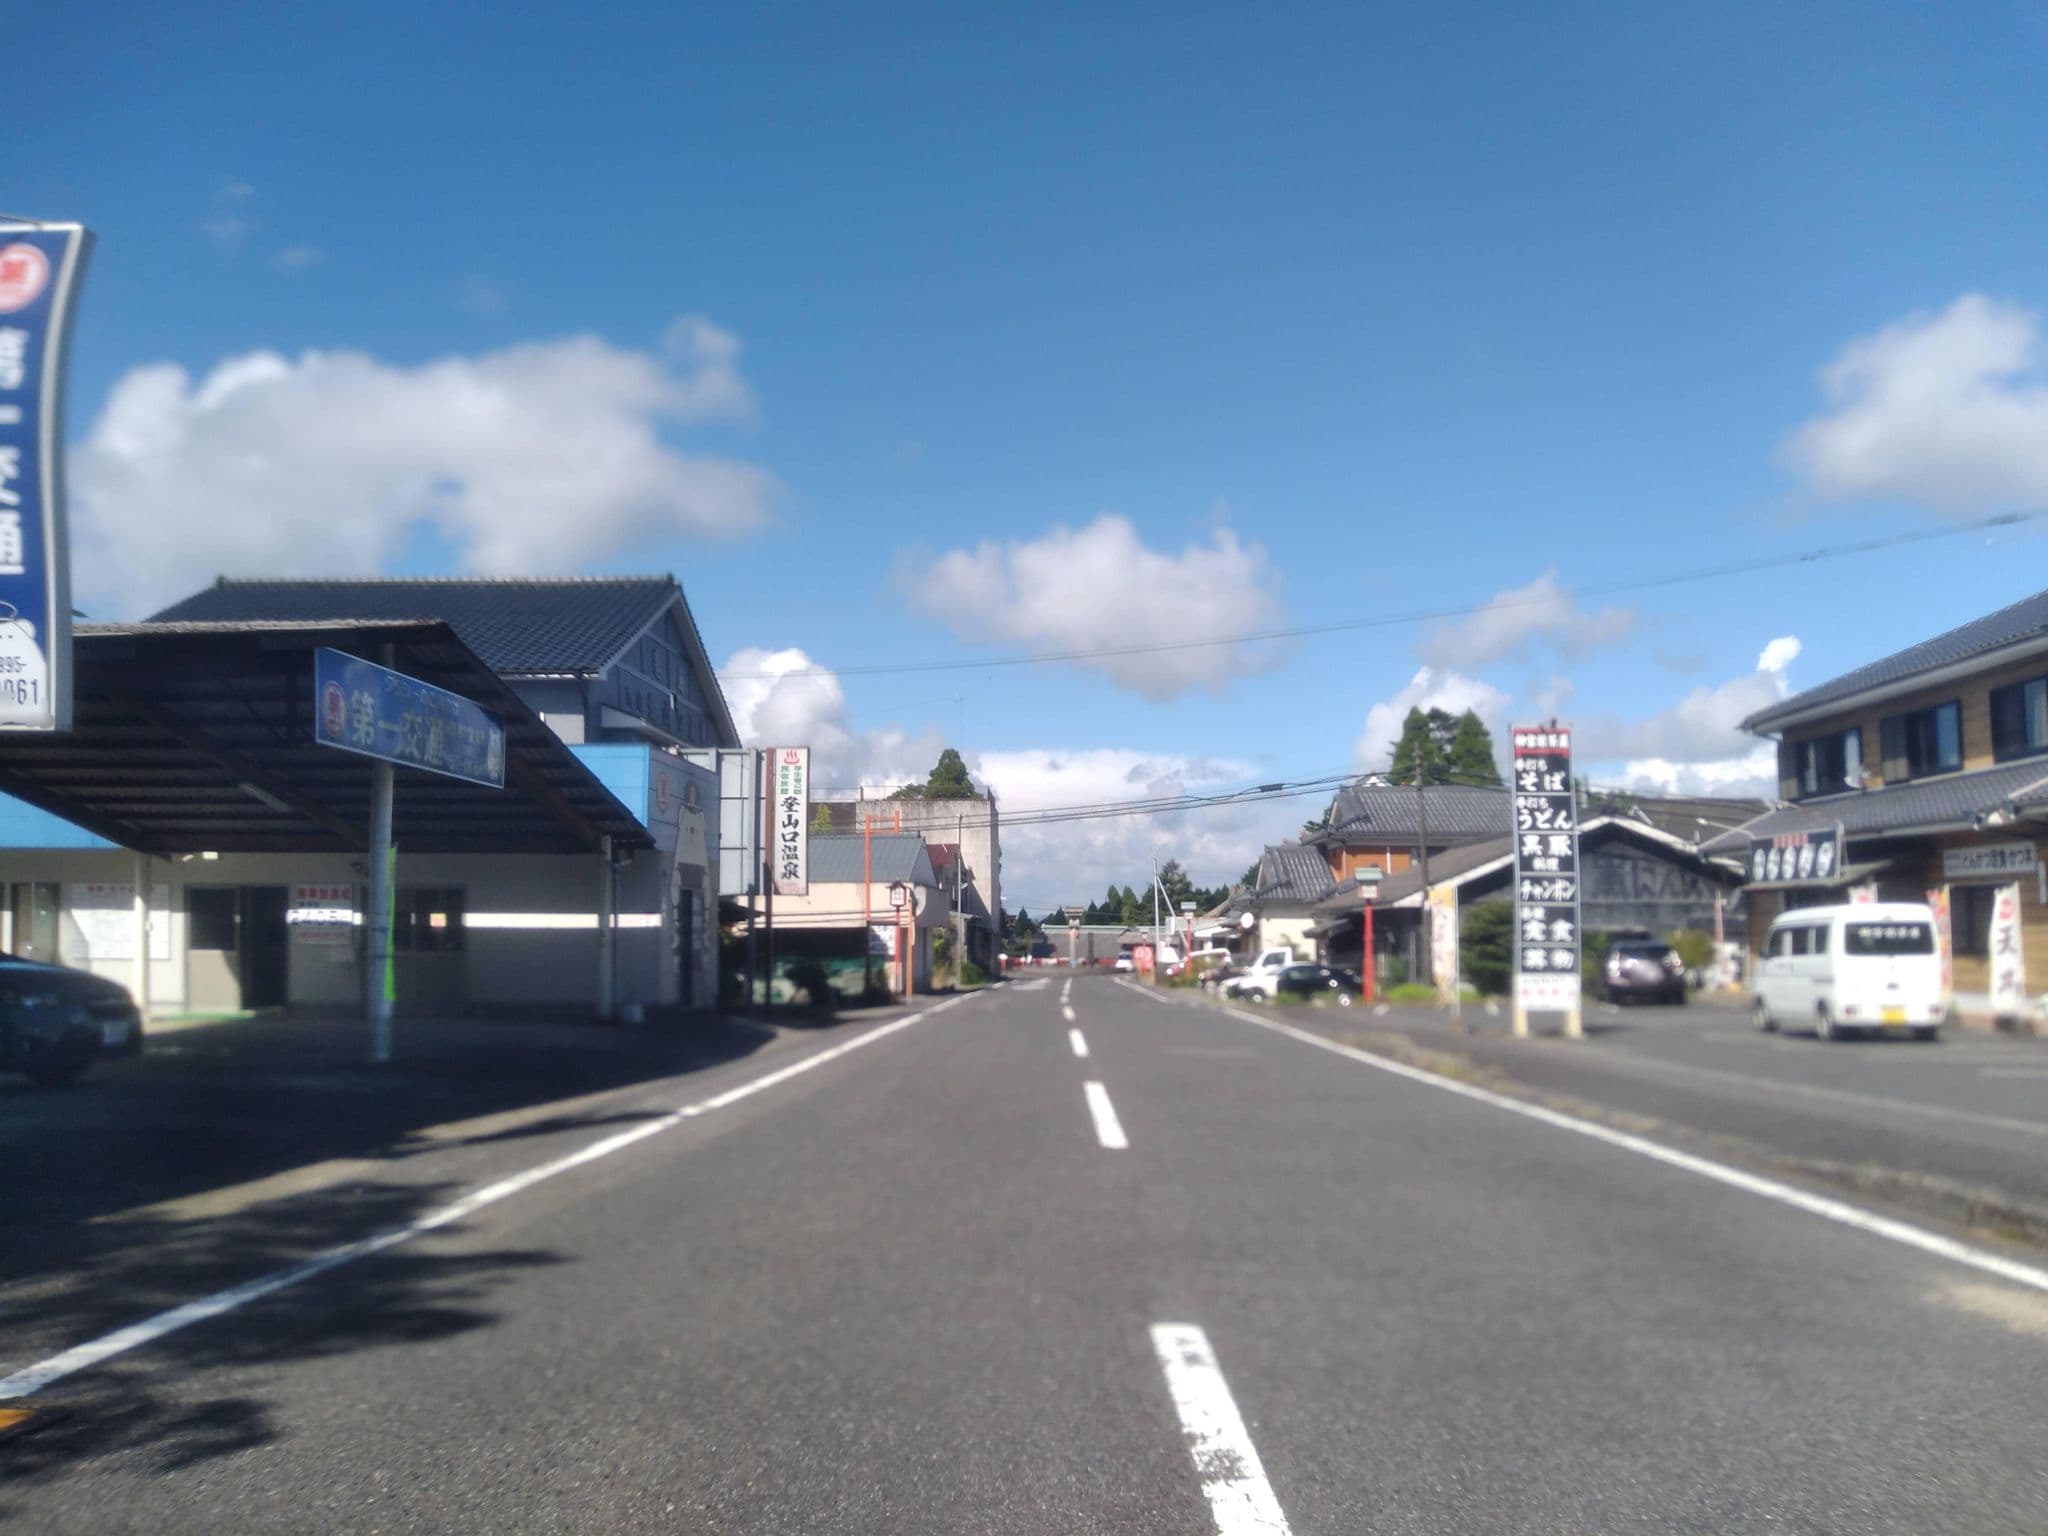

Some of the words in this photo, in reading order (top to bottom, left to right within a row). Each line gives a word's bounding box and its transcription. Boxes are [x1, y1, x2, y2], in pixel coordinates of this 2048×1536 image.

[1519, 771, 1566, 791] そば
[1518, 808, 1573, 830] うどん
[780, 796, 801, 880] 登山口温泉
[1521, 878, 1575, 901] チャンポン
